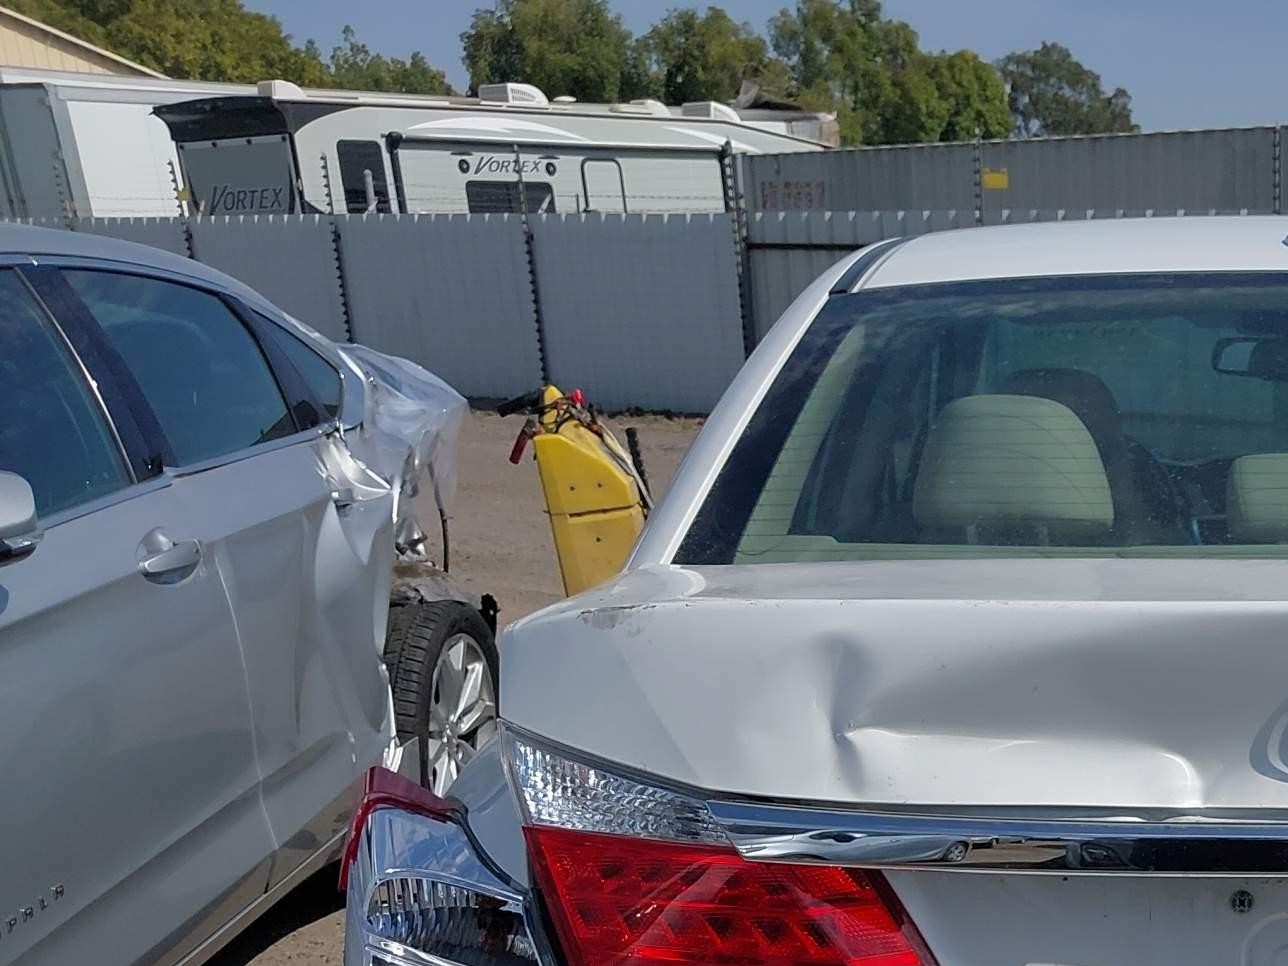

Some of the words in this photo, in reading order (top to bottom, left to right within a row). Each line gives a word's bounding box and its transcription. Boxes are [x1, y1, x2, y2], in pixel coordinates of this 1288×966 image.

[474, 156, 542, 175] VORTEX
[209, 185, 283, 216] VORTEX
[0, 884, 65, 939] PALA
